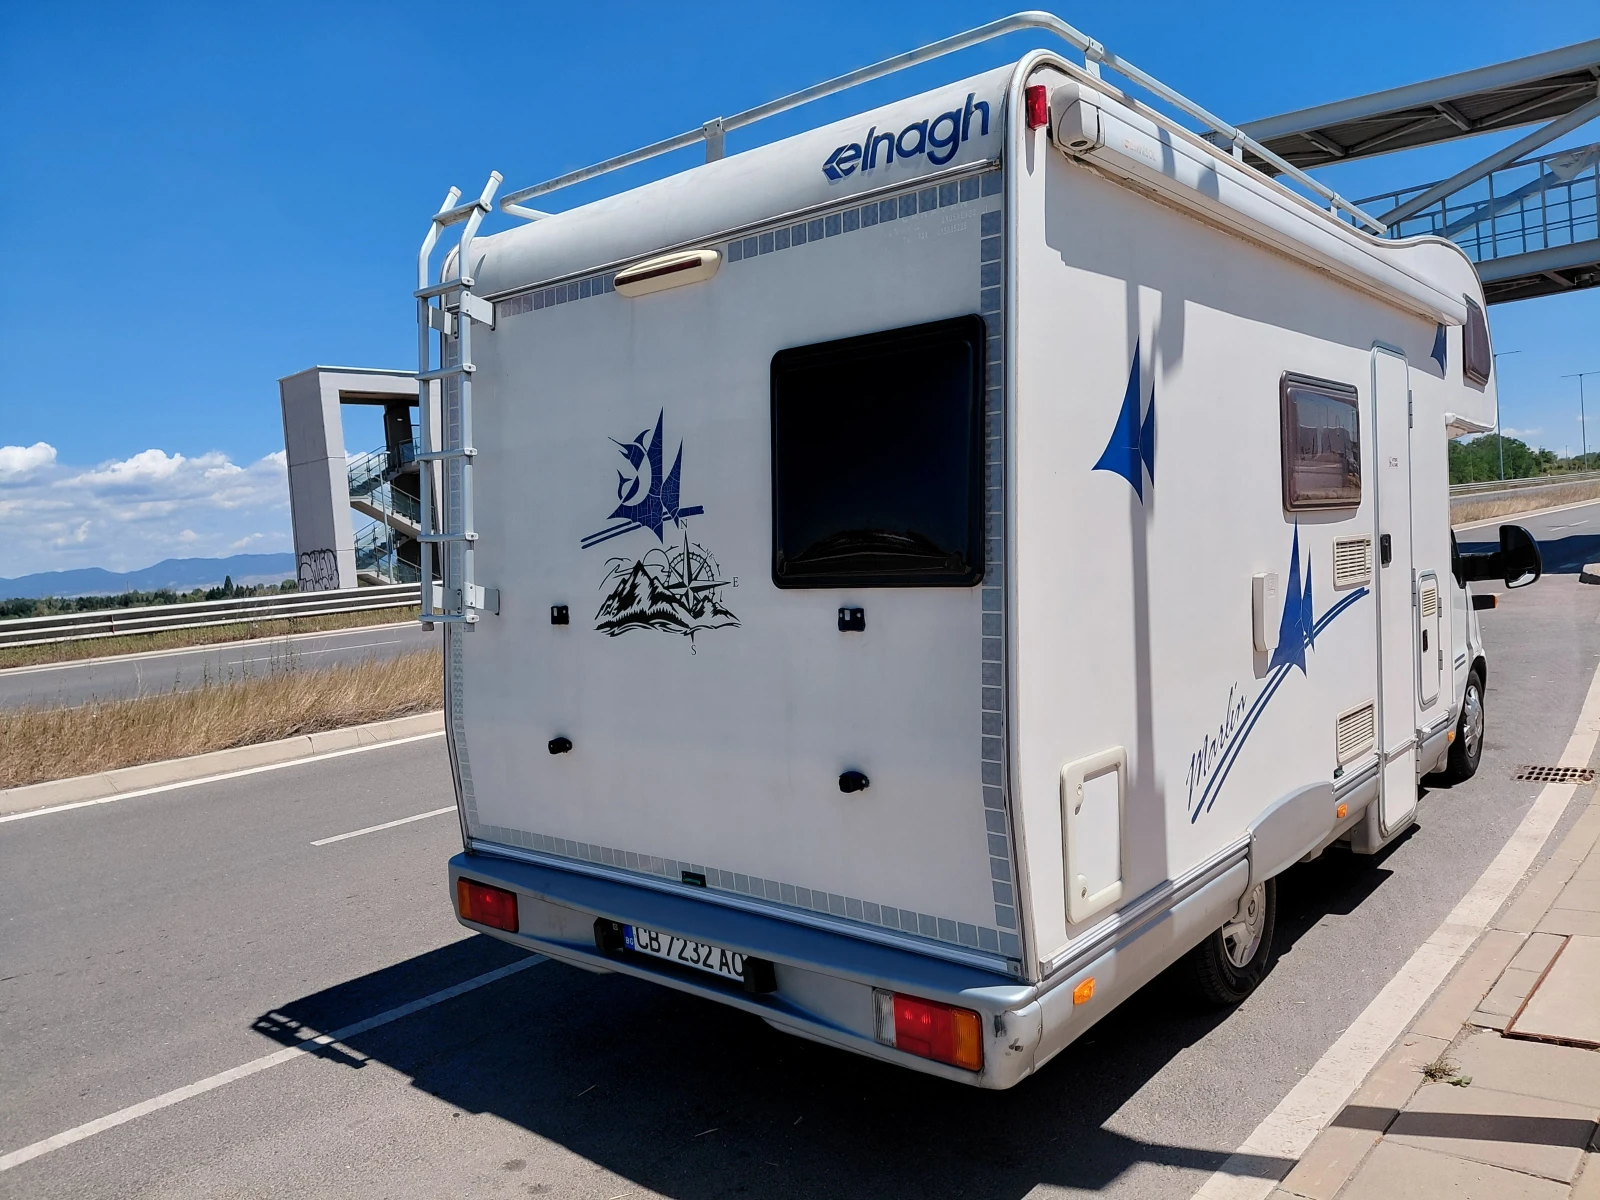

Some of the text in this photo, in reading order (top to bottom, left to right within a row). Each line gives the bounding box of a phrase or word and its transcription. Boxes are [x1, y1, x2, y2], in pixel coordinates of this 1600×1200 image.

[822, 92, 990, 181] elnagh
[680, 518, 688, 530] N
[732, 576, 740, 588] E
[690, 644, 697, 656] S
[625, 936, 634, 946] BG
[635, 926, 662, 953] CB
[666, 936, 715, 969] 7232
